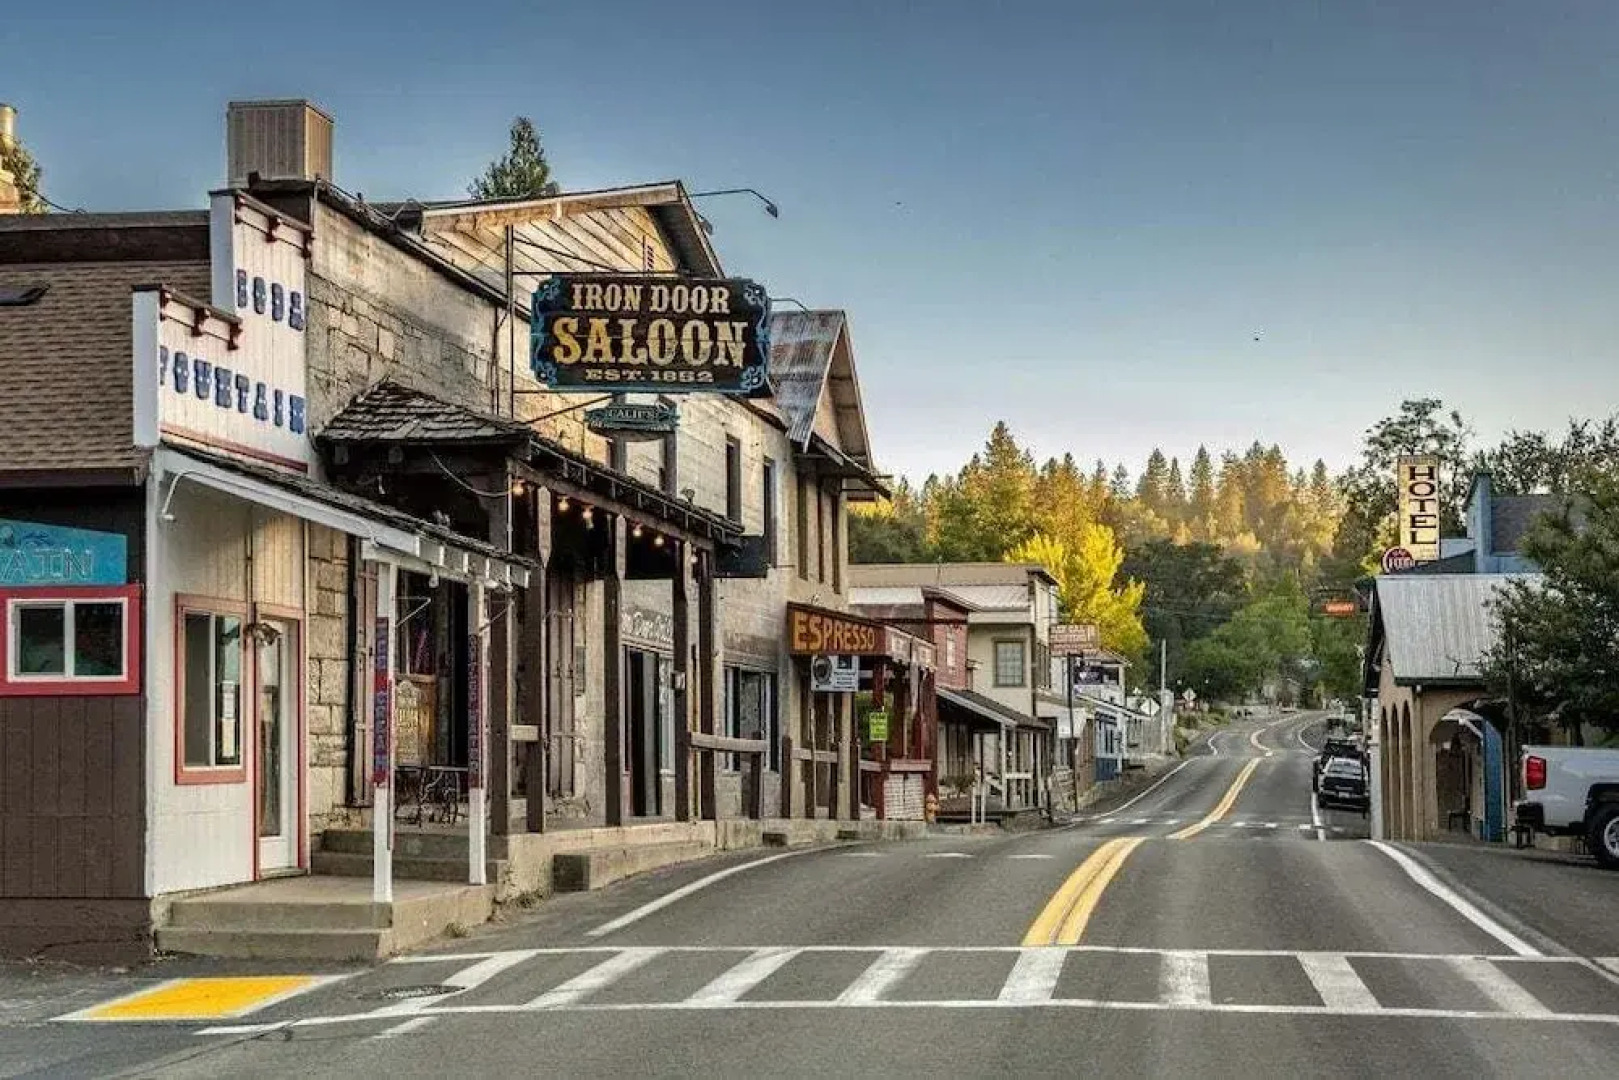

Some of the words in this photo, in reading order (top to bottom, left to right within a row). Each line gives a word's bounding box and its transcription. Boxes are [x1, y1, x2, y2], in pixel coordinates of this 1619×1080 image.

[571, 283, 643, 312] IRON
[649, 284, 731, 314] DOOR
[553, 317, 748, 369] SALOON
[585, 368, 646, 381] EST.
[650, 369, 715, 382] 1852
[1409, 465, 1437, 545] HOTEL
[794, 611, 875, 651] ESPRESSO
